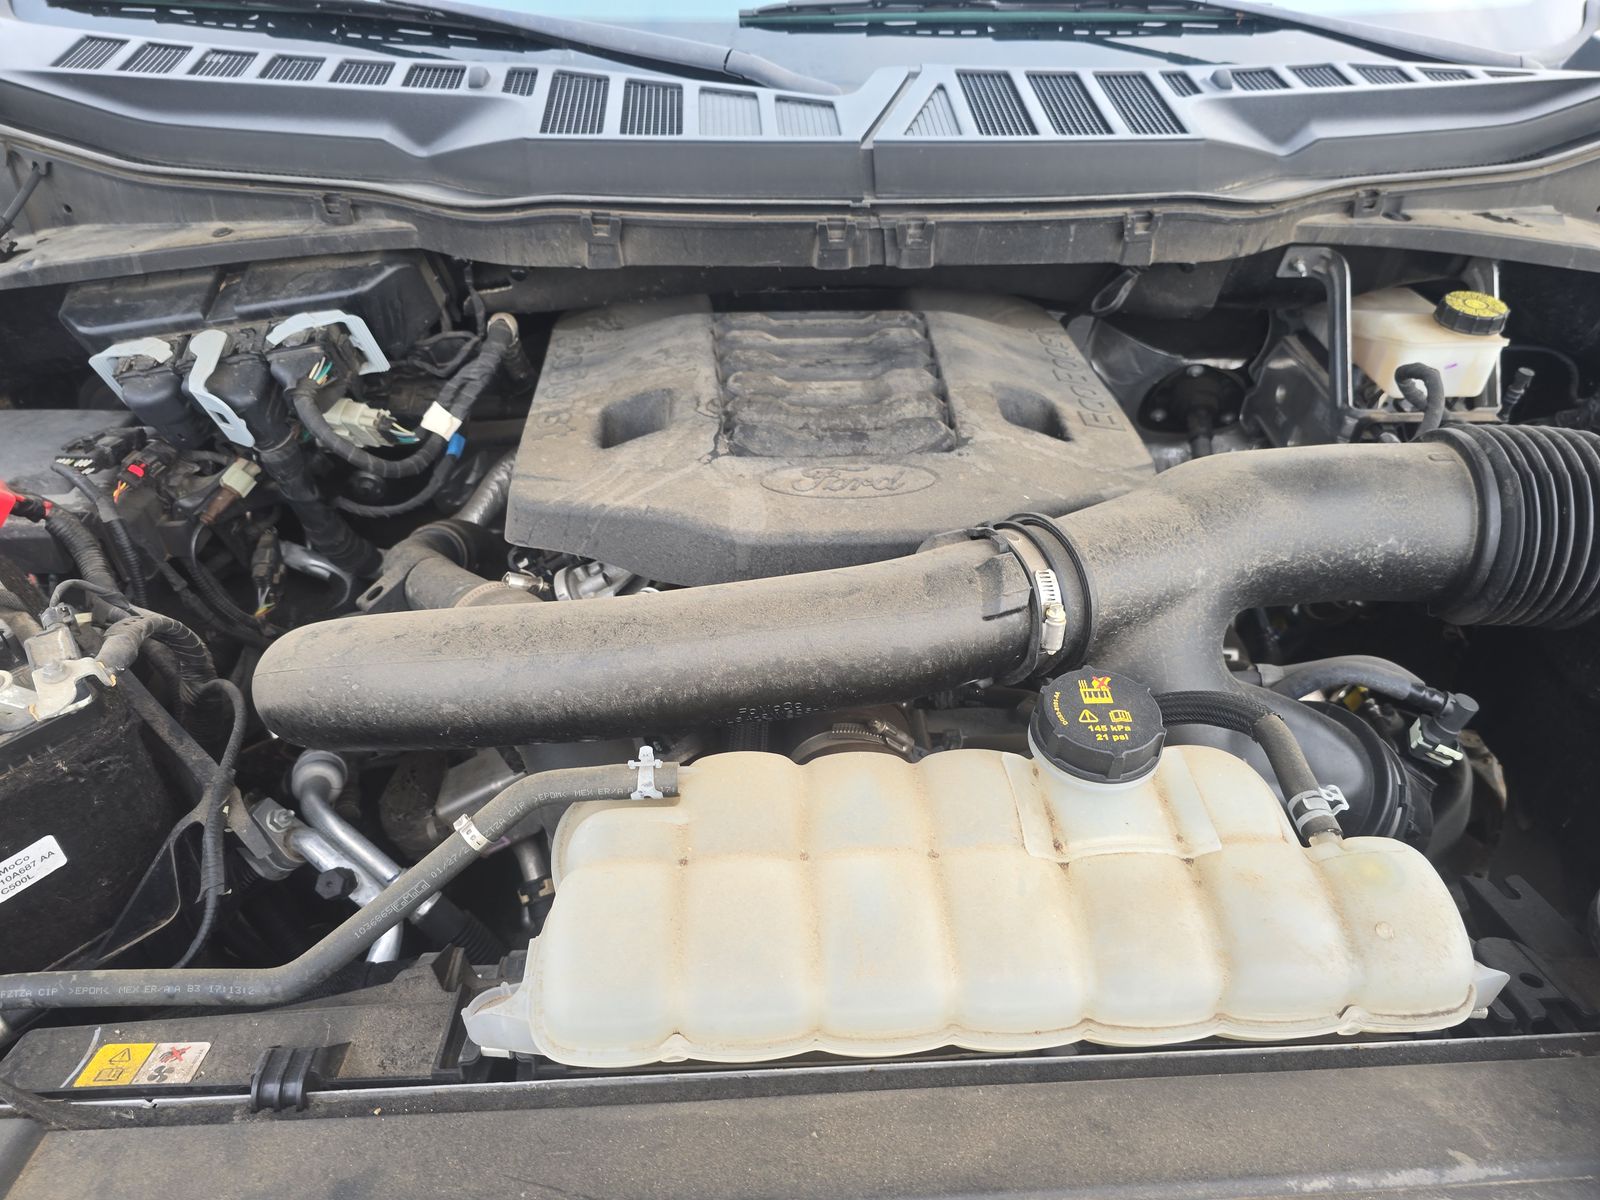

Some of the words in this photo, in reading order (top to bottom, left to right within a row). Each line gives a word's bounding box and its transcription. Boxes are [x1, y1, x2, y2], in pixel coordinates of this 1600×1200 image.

[791, 466, 905, 492] Ford
[1088, 724, 1107, 732] 145
[1110, 724, 1131, 732] kPa
[1096, 733, 1109, 741] 21
[1112, 733, 1129, 742] psi
[574, 788, 593, 797] MEX
[40, 850, 55, 862] AA
[38, 987, 58, 997] CIP
[118, 985, 140, 994] MEX
